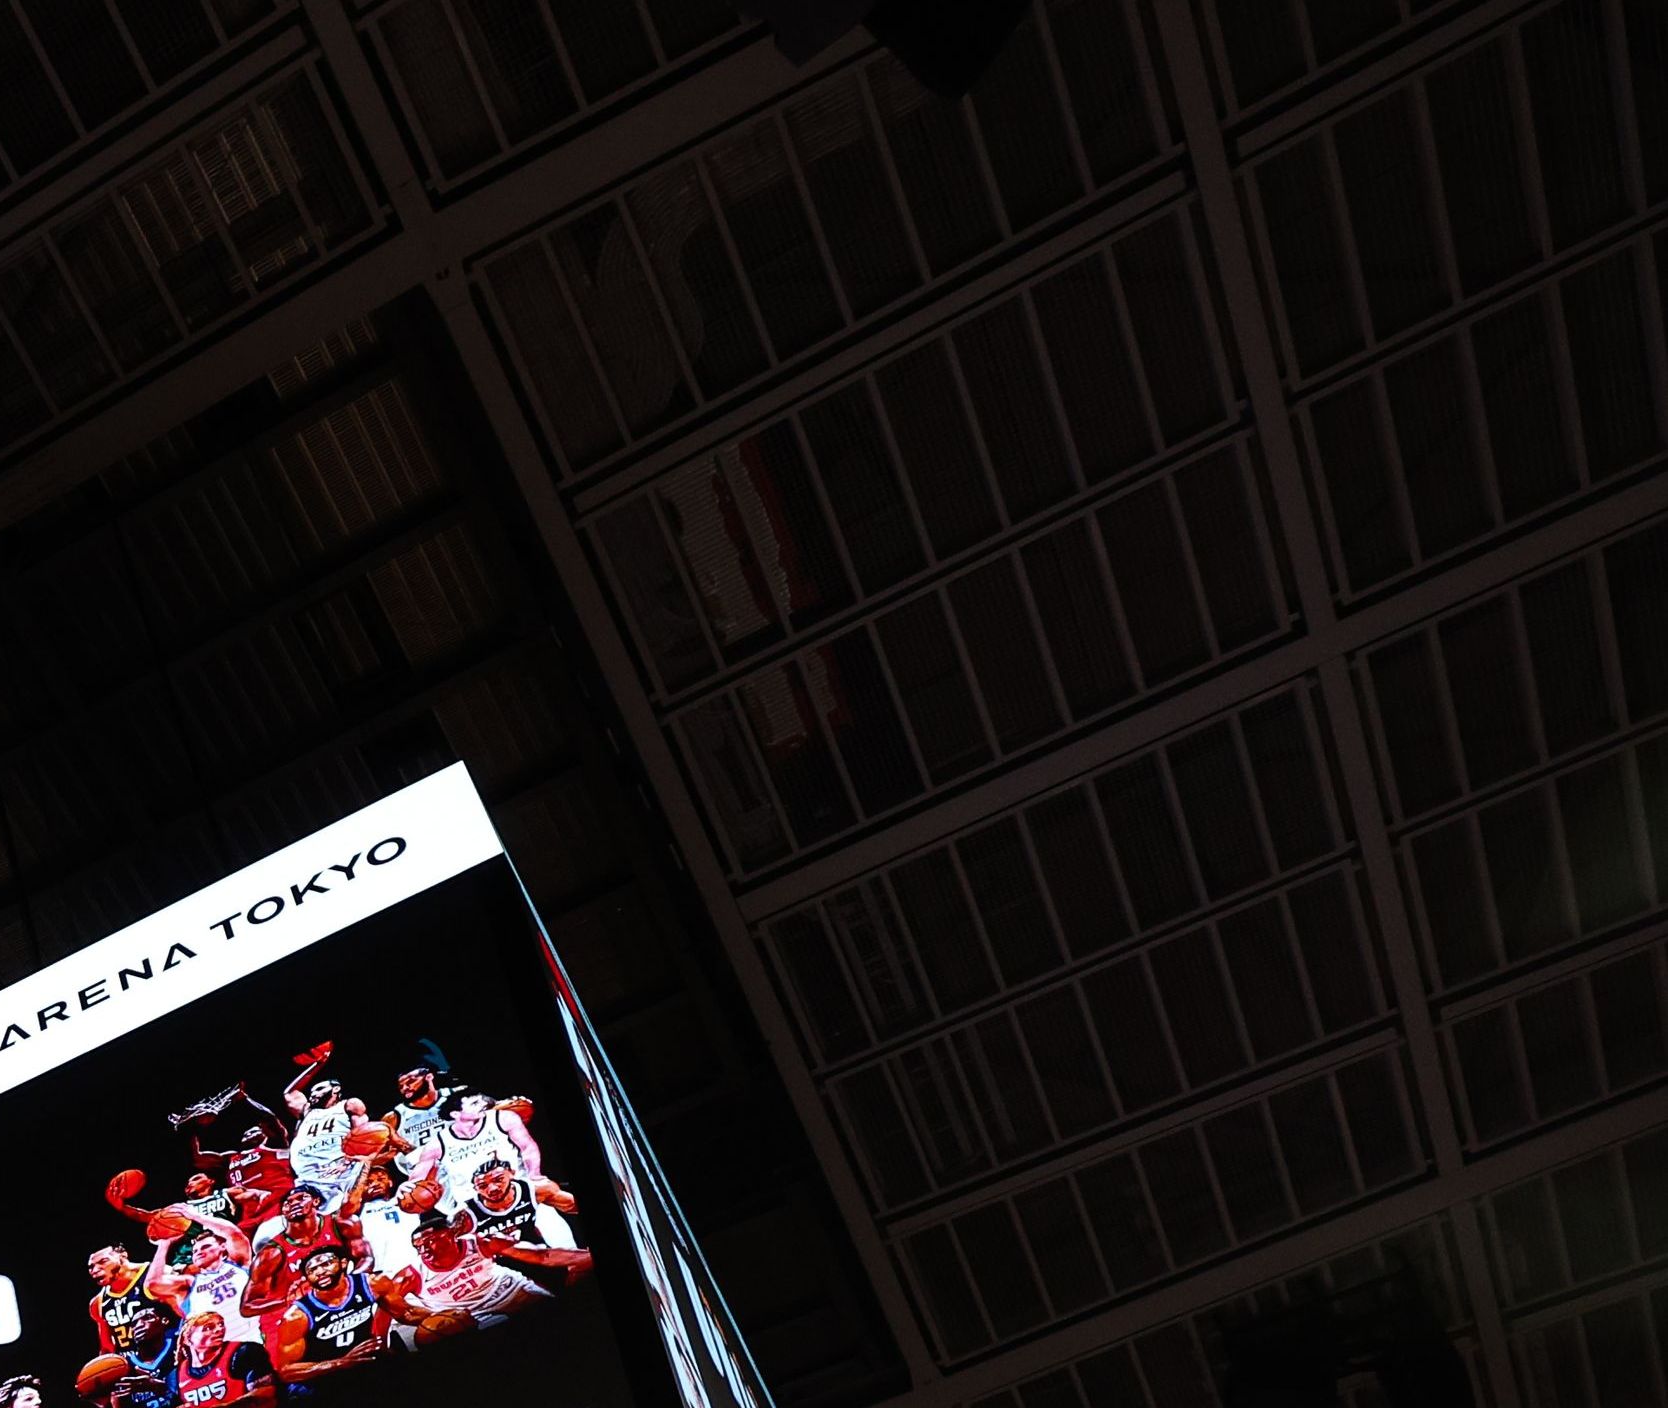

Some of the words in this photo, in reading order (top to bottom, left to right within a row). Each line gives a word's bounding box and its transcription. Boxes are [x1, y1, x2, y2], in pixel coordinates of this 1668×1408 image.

[209, 835, 408, 941] TOKYO
[307, 1118, 335, 1137] 44
[195, 1198, 226, 1215] ERD
[184, 1379, 226, 1406] 905
